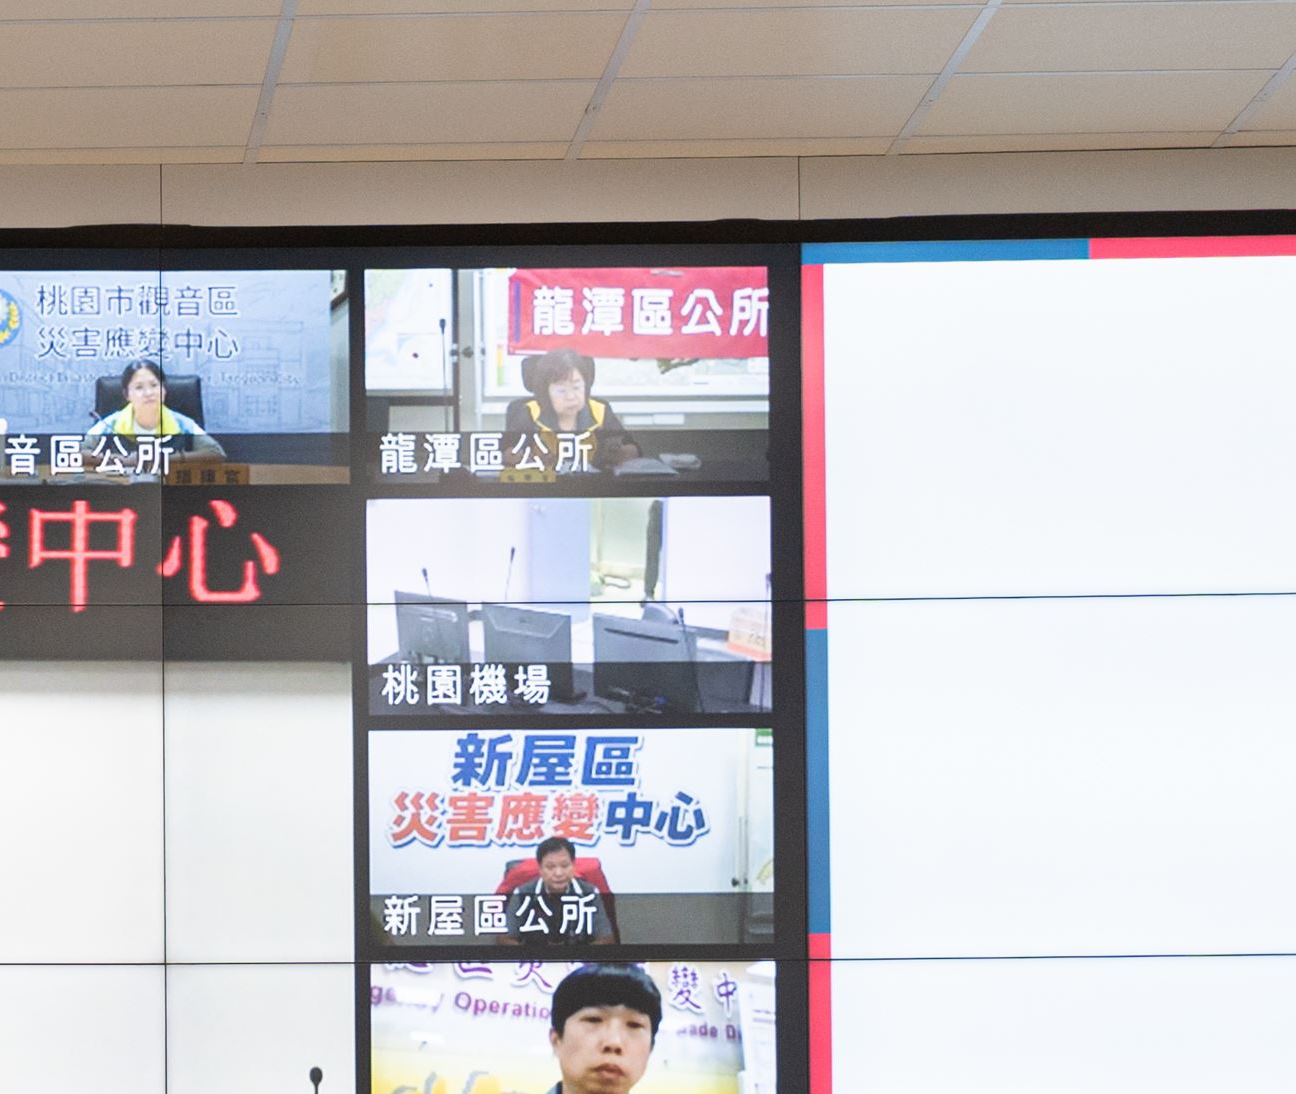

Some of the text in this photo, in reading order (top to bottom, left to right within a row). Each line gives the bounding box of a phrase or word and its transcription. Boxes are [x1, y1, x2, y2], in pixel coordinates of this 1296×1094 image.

[35, 284, 239, 317] 桃園市觀音區
[533, 286, 768, 337] 龍潭區公所
[35, 326, 239, 360] 災害應變中心
[379, 431, 594, 475] 龍潭區公所
[382, 664, 552, 706] 桃園機場
[449, 733, 640, 788] 新屋區
[388, 791, 707, 844] 災害應變中心
[383, 894, 598, 937] 新屋區公所
[454, 991, 551, 1020] Operatio
